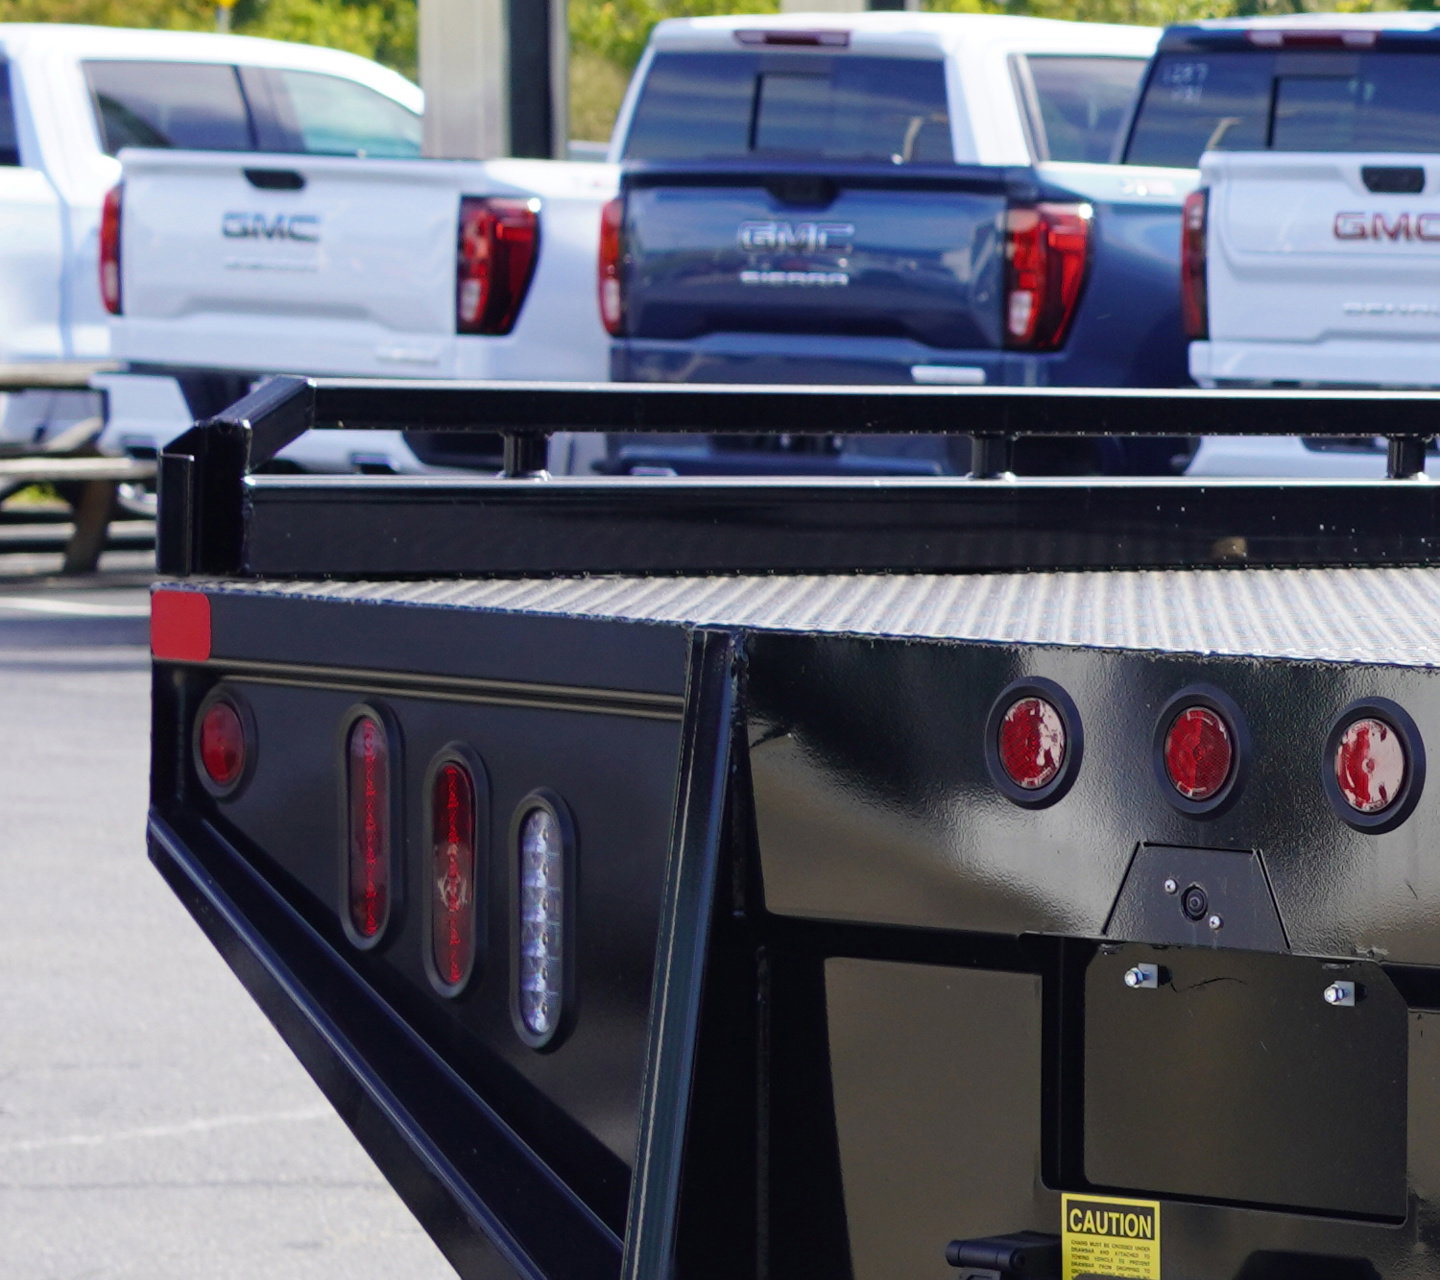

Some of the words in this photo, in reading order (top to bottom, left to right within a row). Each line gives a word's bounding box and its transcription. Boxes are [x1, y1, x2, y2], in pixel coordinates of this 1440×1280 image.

[223, 211, 321, 243] GMC
[737, 219, 856, 251] GMC
[1070, 1208, 1151, 1238] CAUTION
